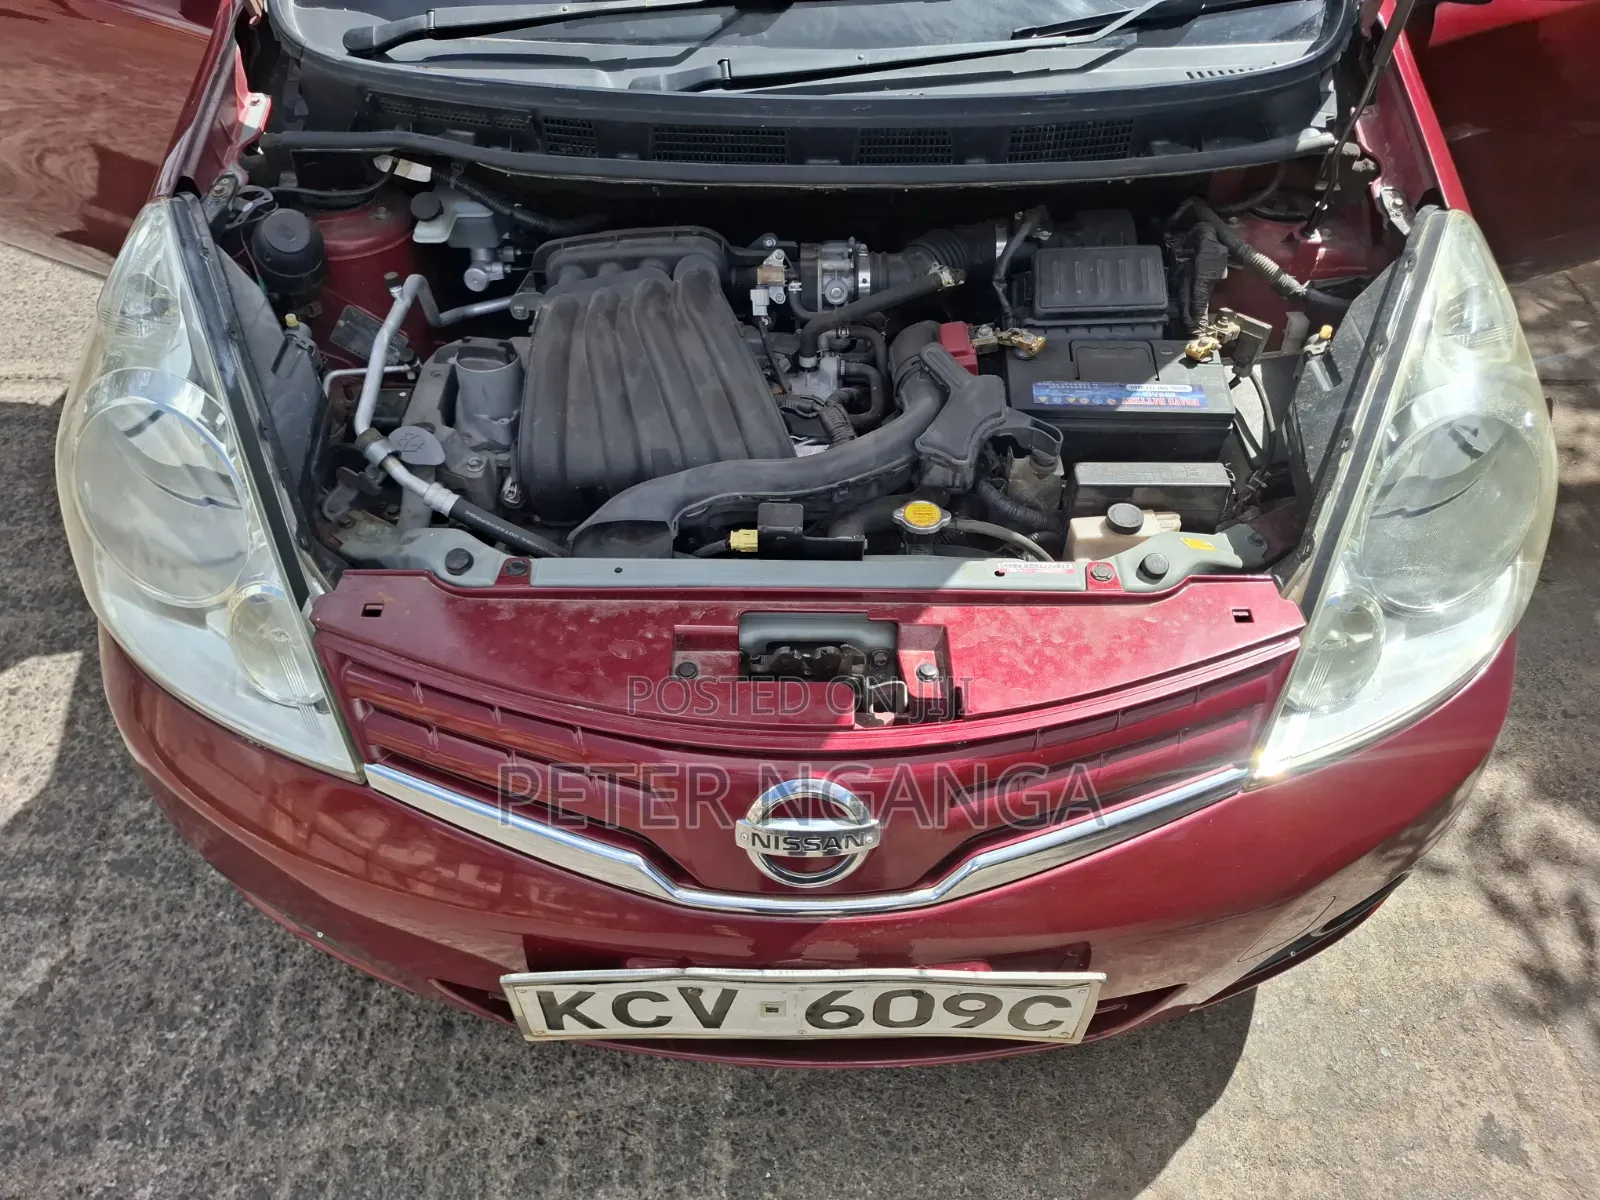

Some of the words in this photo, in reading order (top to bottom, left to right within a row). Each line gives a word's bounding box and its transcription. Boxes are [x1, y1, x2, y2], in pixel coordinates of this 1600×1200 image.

[751, 832, 865, 852] NISSAN
[536, 986, 736, 1032] KCV
[803, 988, 1074, 1032] 609C
